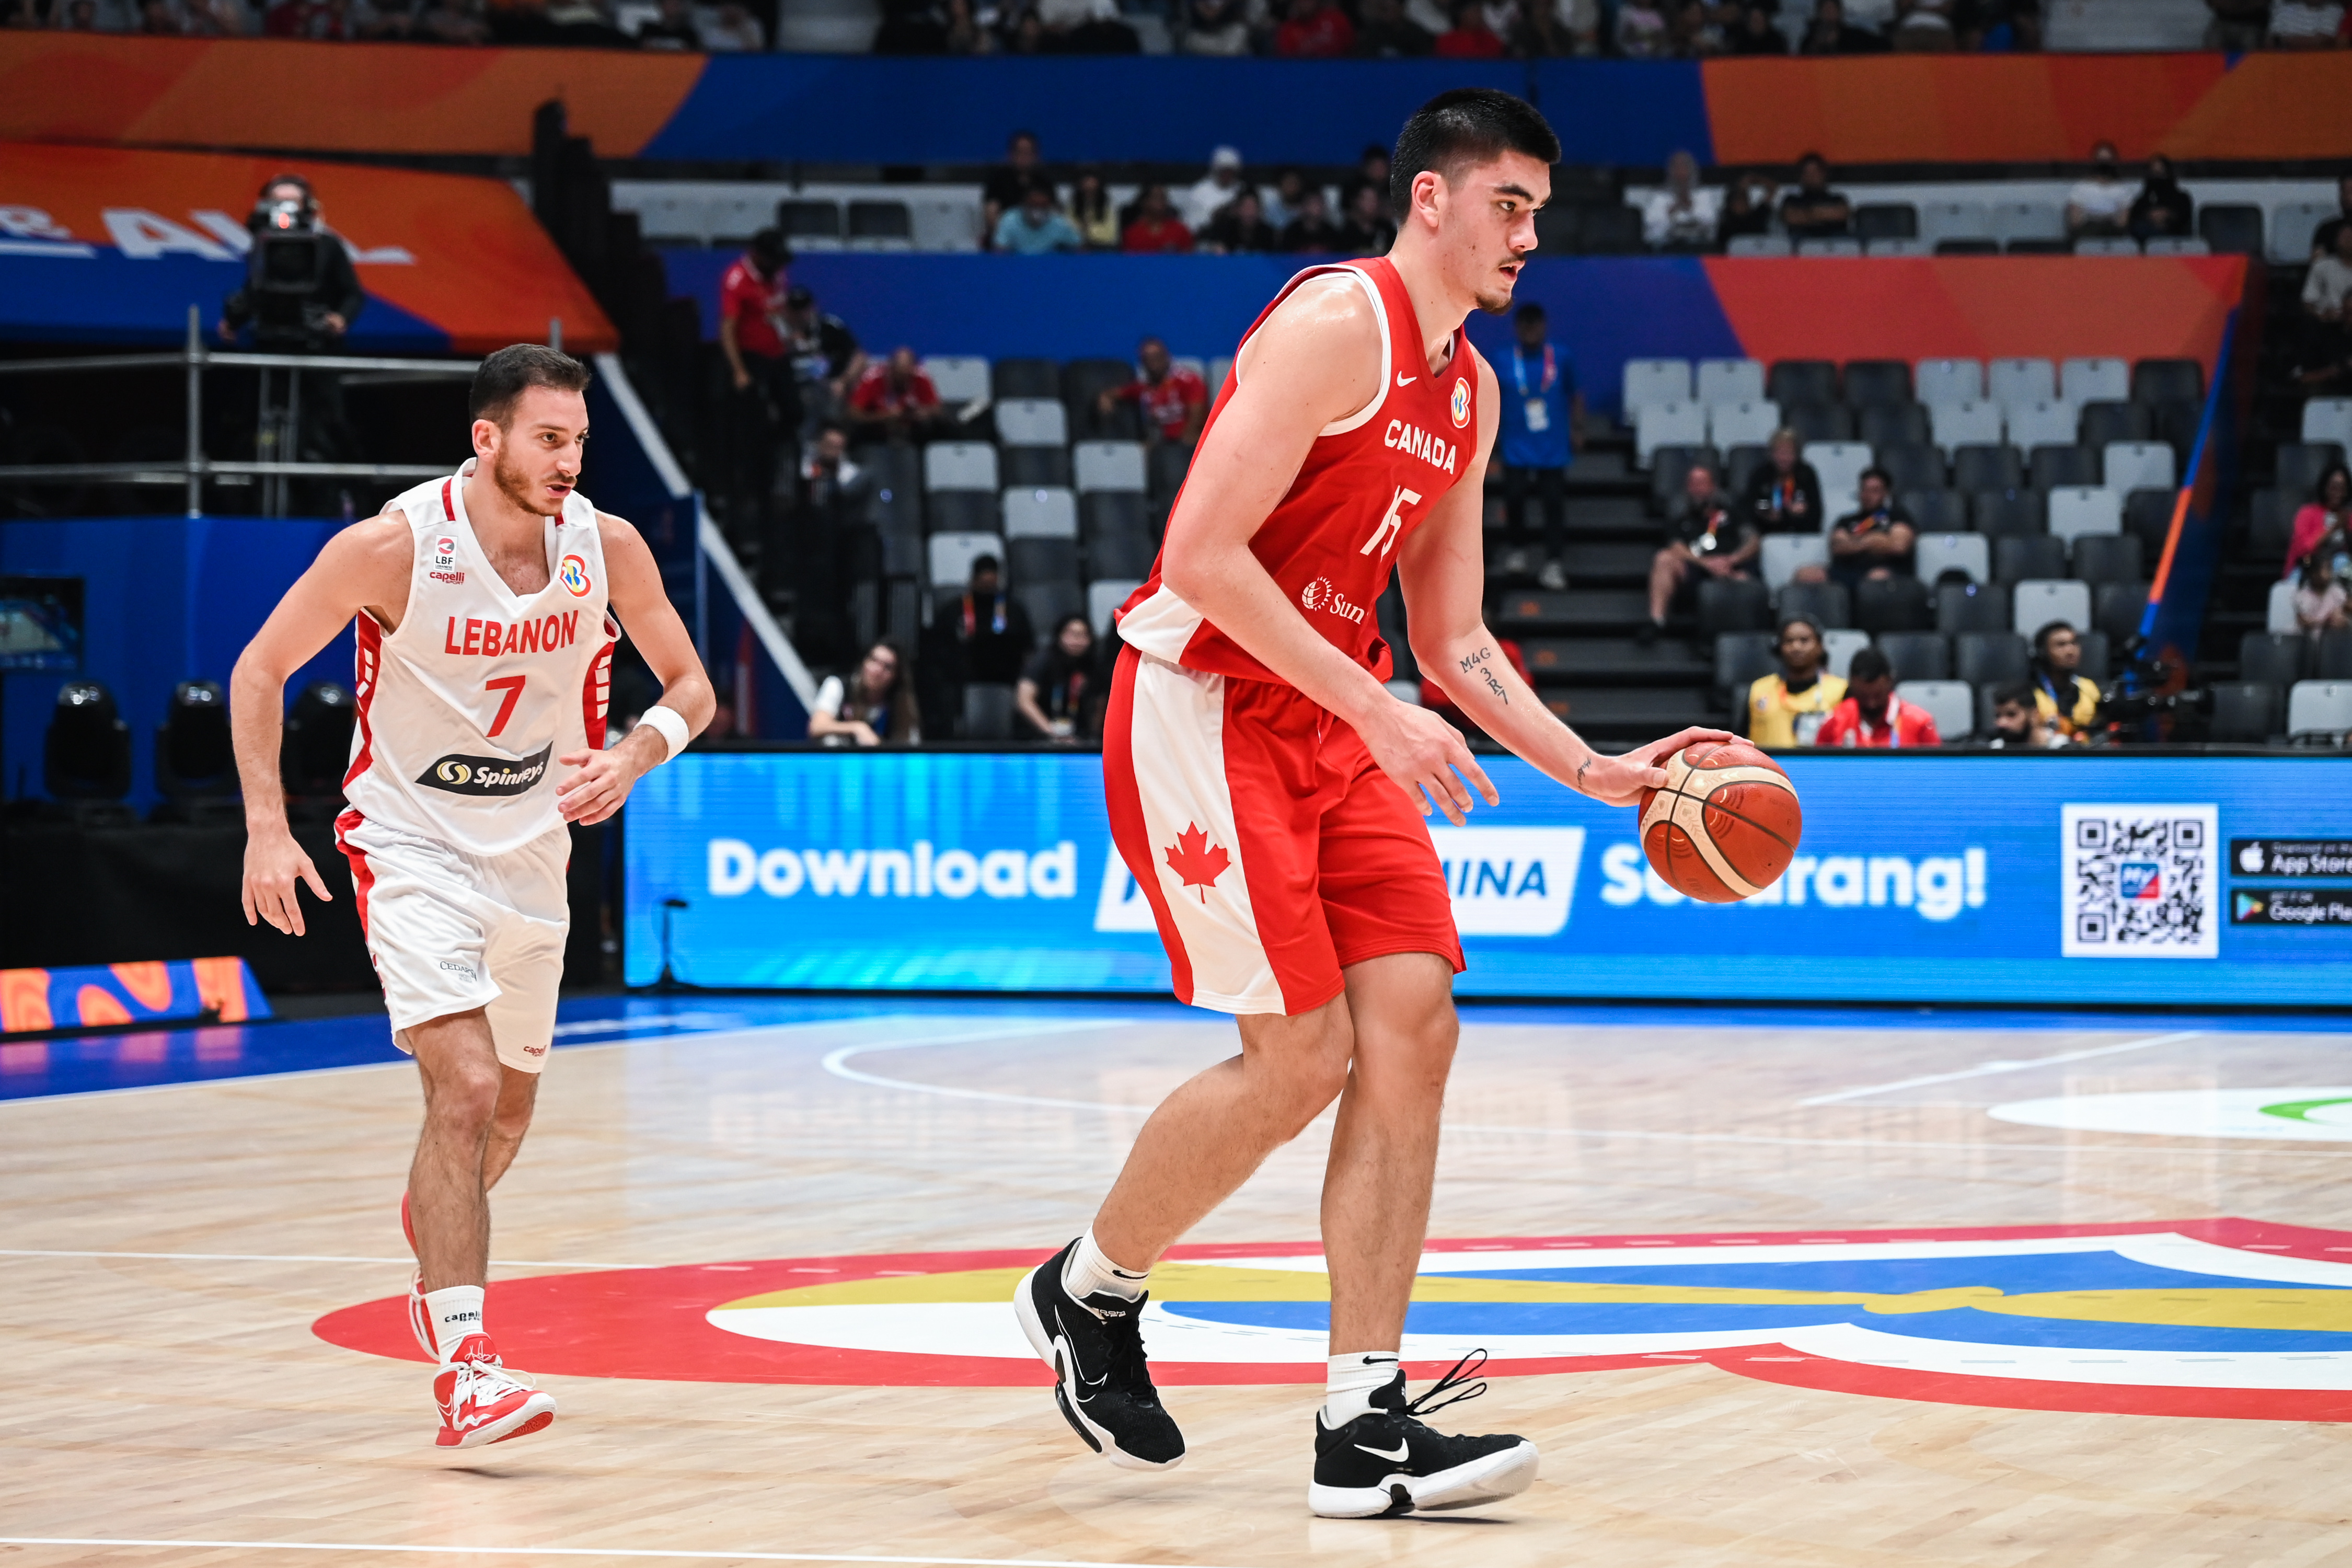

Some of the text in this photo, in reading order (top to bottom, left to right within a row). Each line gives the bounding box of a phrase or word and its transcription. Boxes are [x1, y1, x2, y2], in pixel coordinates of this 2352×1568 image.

[1384, 419, 1456, 475] CANADA
[1359, 485, 1422, 563] 15
[430, 572, 465, 582] capelli
[435, 556, 453, 564] LBF
[1329, 593, 1365, 625] Sun
[445, 610, 579, 657] LEBANON
[1459, 647, 1491, 674] M4G
[485, 675, 526, 737] 7
[709, 839, 1077, 899] Download
[1440, 859, 1548, 897] INA
[2271, 852, 2309, 877] App
